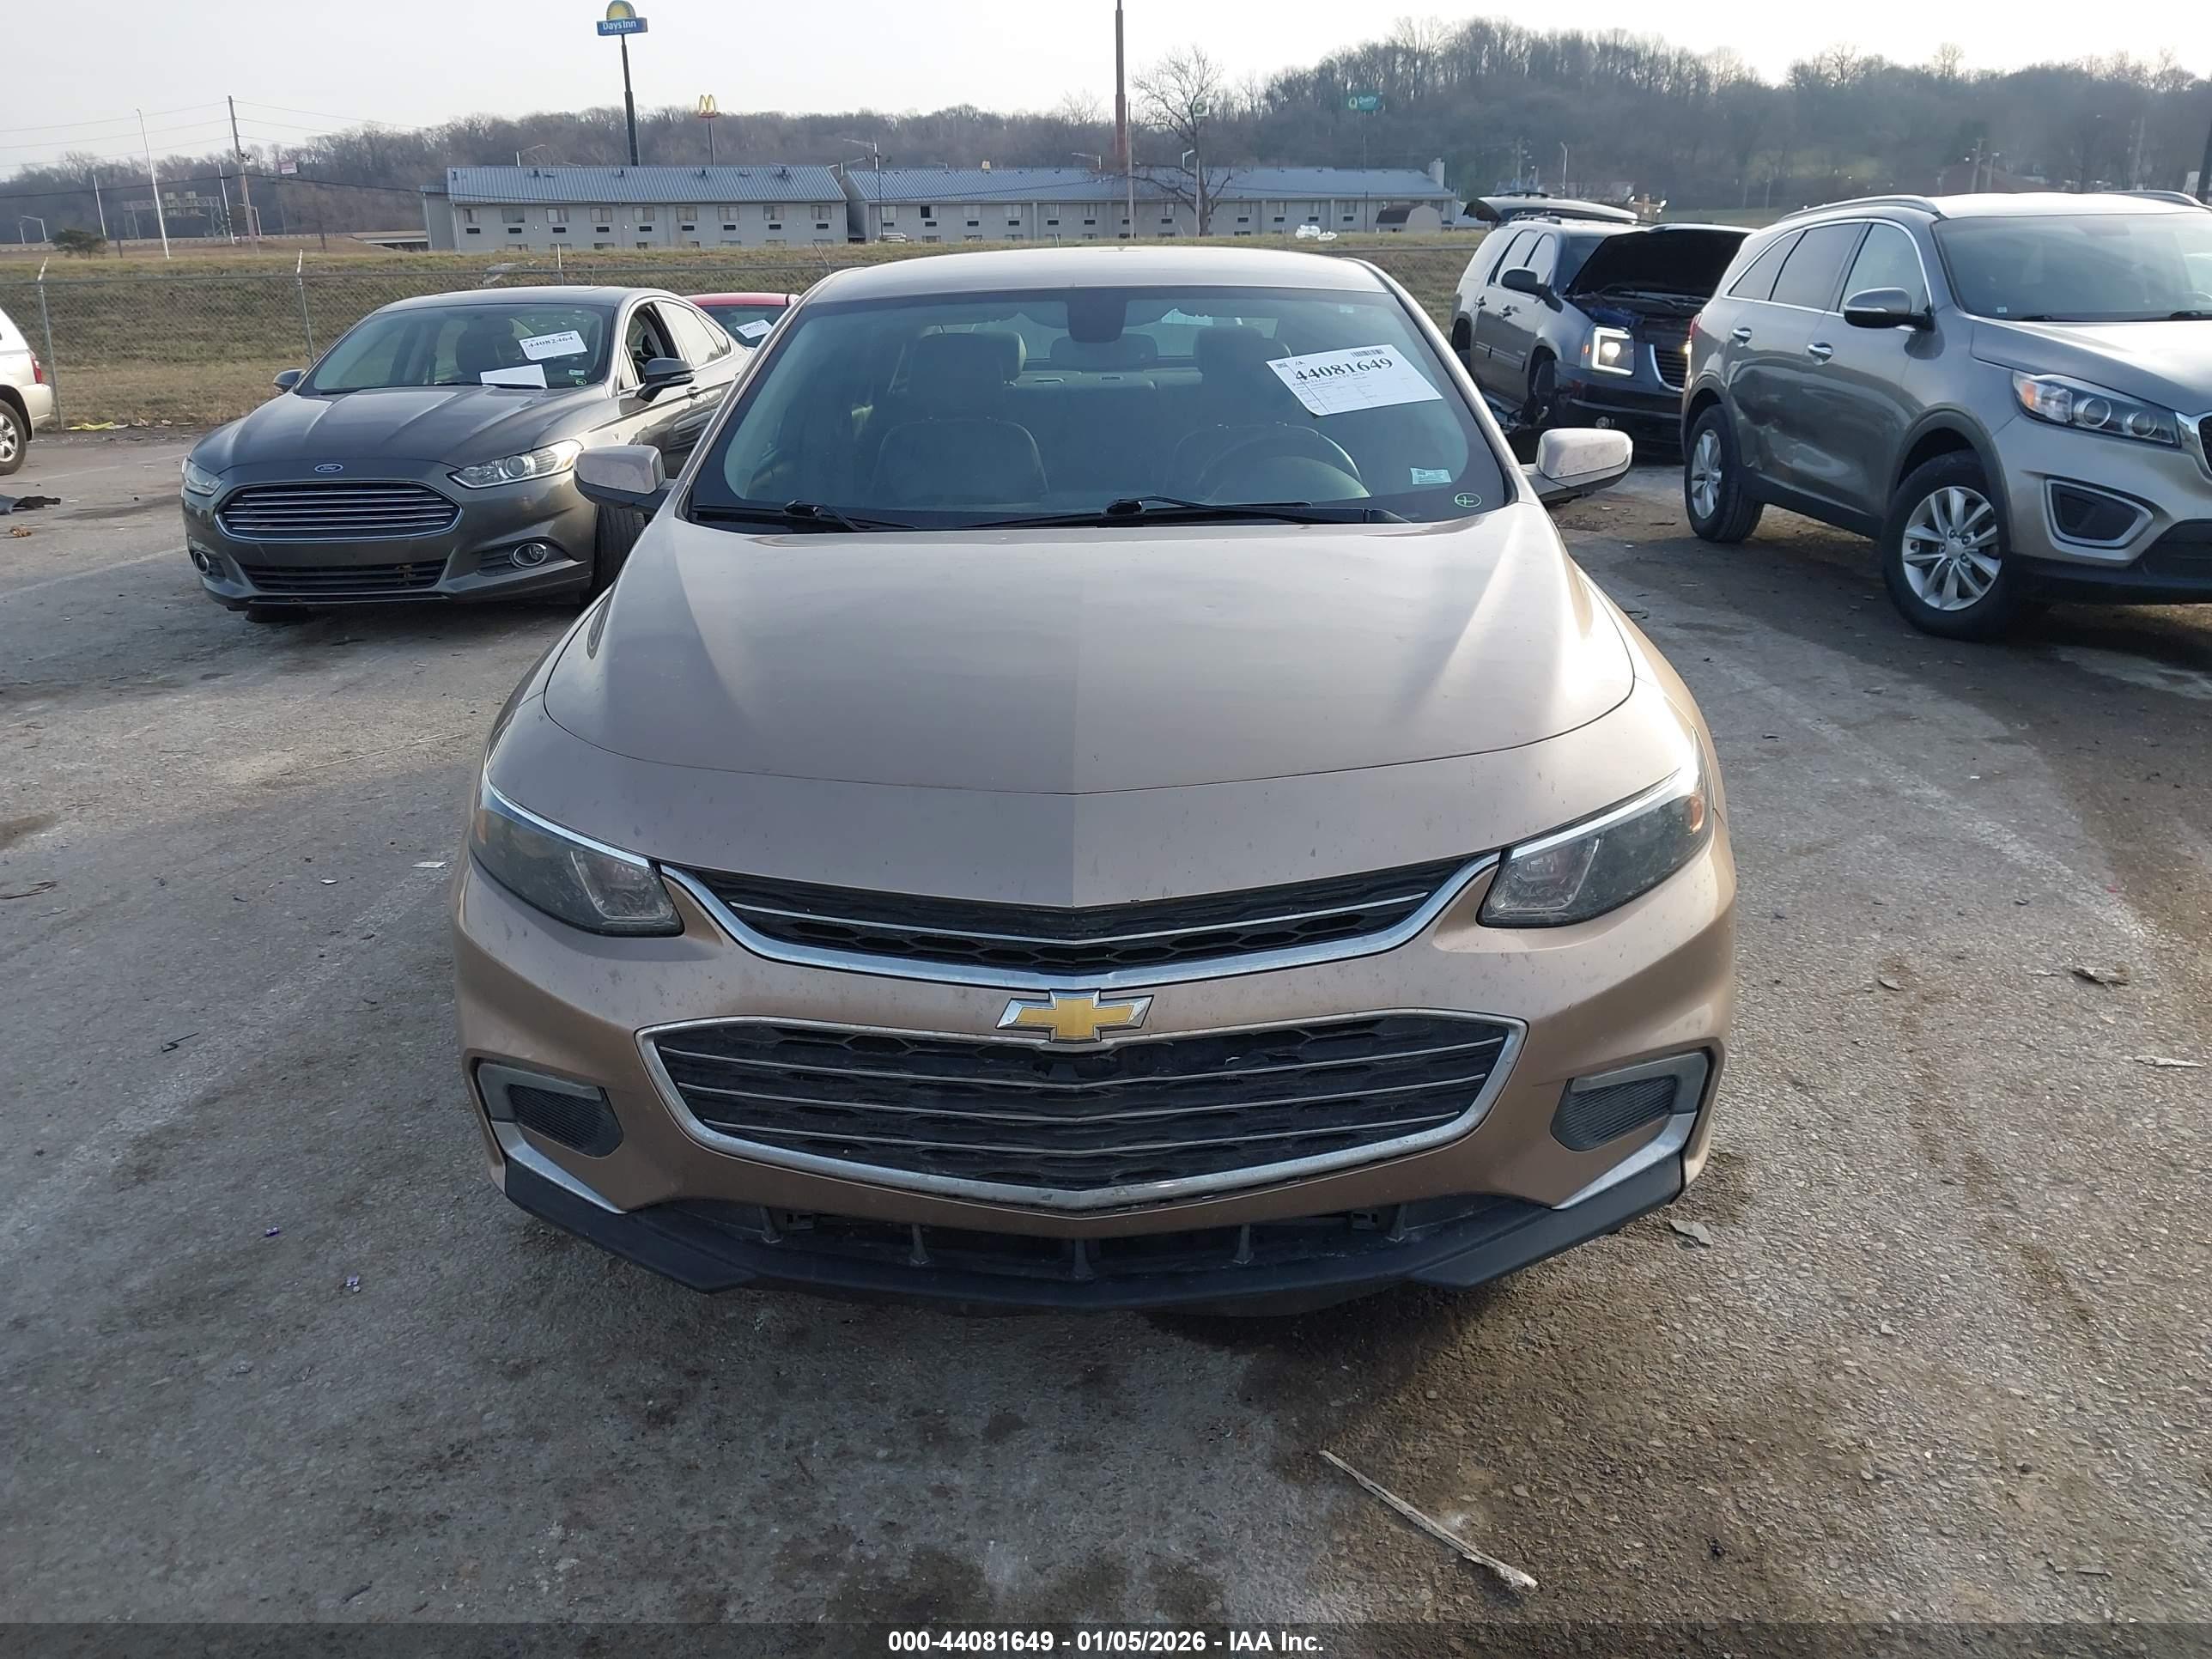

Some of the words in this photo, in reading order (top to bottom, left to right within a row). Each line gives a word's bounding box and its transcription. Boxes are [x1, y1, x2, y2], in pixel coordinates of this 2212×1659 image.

[603, 21, 623, 31] Days
[623, 20, 636, 29] Inn
[1295, 357, 1393, 380] 44081649
